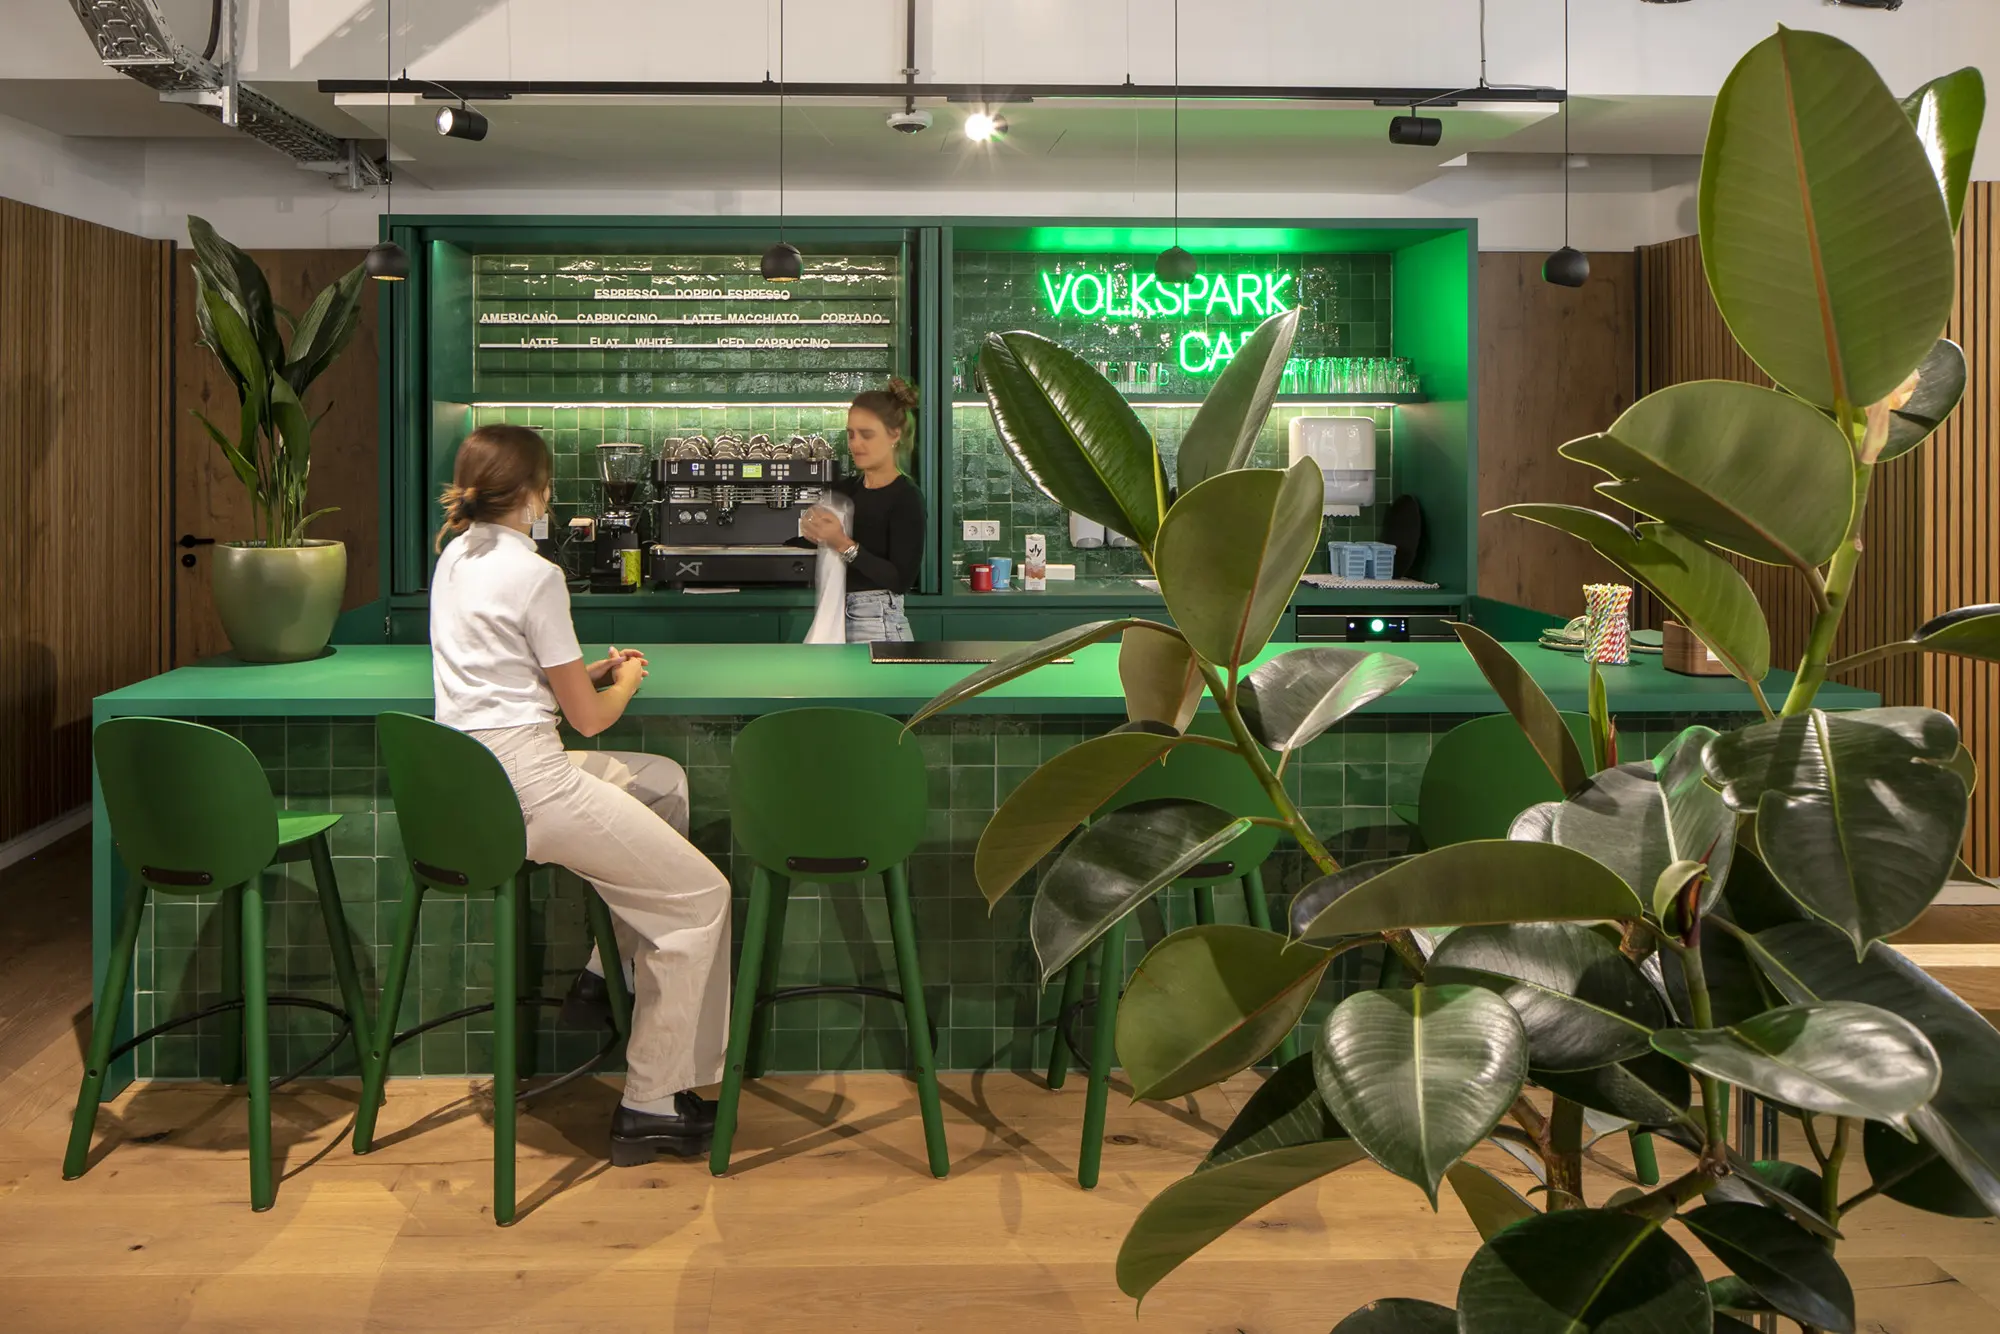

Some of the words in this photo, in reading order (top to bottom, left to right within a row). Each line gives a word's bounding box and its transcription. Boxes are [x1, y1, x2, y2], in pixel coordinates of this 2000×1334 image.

[594, 289, 660, 299] ESPRESSO
[674, 289, 722, 299] DOPPIO
[727, 289, 791, 300] ESPRESSO
[1042, 272, 1292, 316] VOLKSPARK
[480, 313, 558, 324] AMERICANO
[577, 313, 658, 324] CAPPUCCINO
[683, 314, 722, 324] LATTE
[727, 313, 800, 324] MACCHIATO
[820, 313, 883, 324] CORTADO
[521, 337, 559, 348] LATTE
[589, 337, 620, 348] FLAT
[635, 337, 673, 348] WHITE
[717, 338, 745, 348] ICED
[755, 338, 831, 349] CAPPUCCINO
